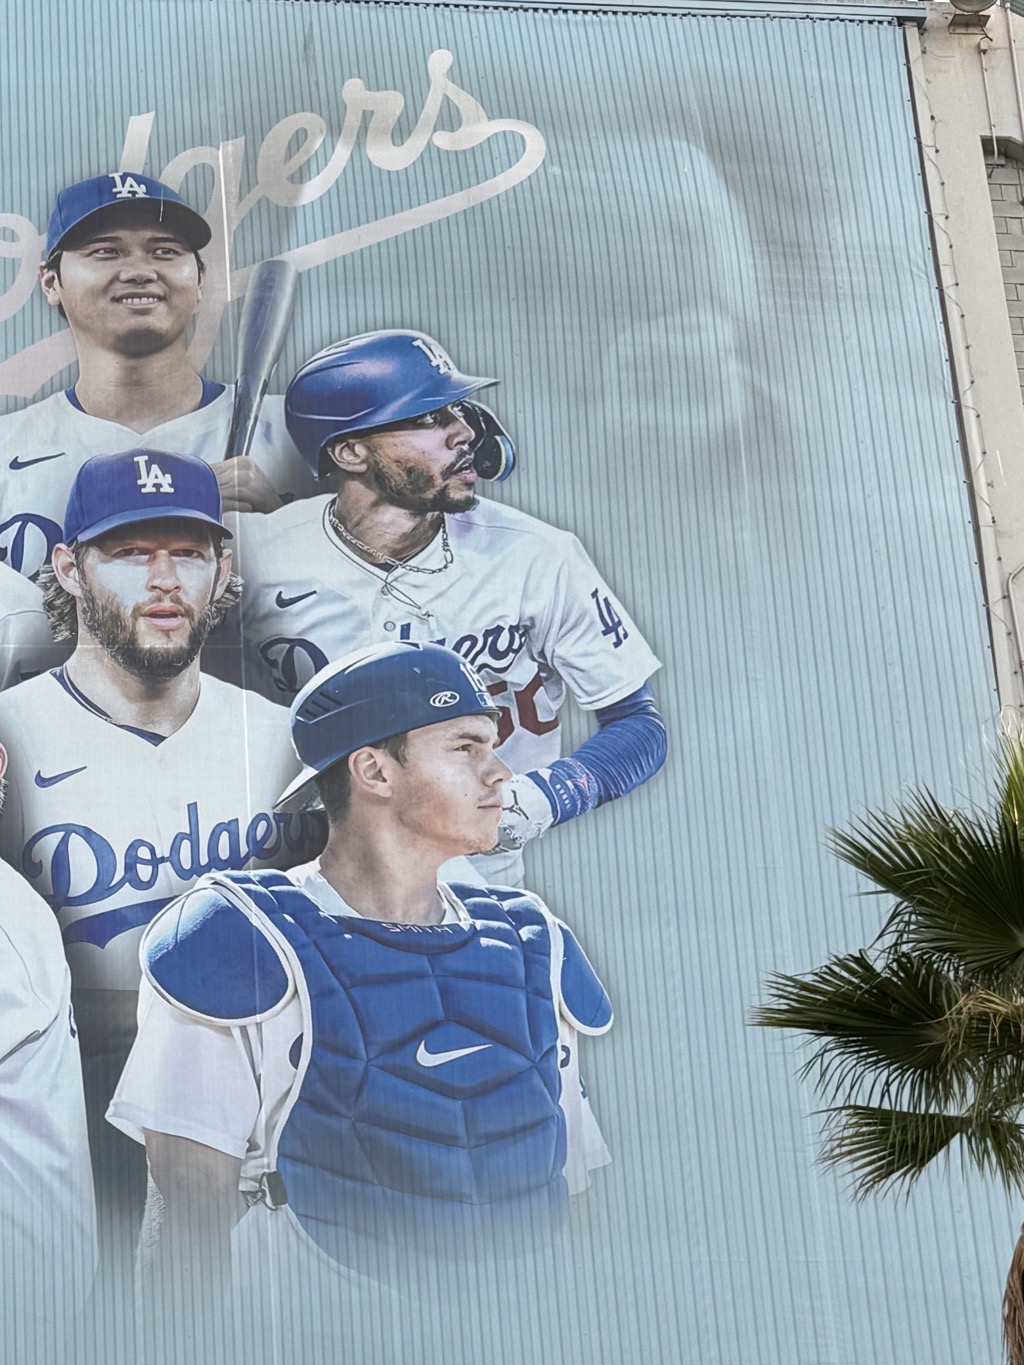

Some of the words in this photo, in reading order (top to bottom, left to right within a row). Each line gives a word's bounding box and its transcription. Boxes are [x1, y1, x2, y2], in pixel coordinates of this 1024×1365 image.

[108, 172, 150, 198] LA
[412, 339, 451, 374] LA
[133, 455, 175, 493] LA
[590, 588, 628, 648] LA
